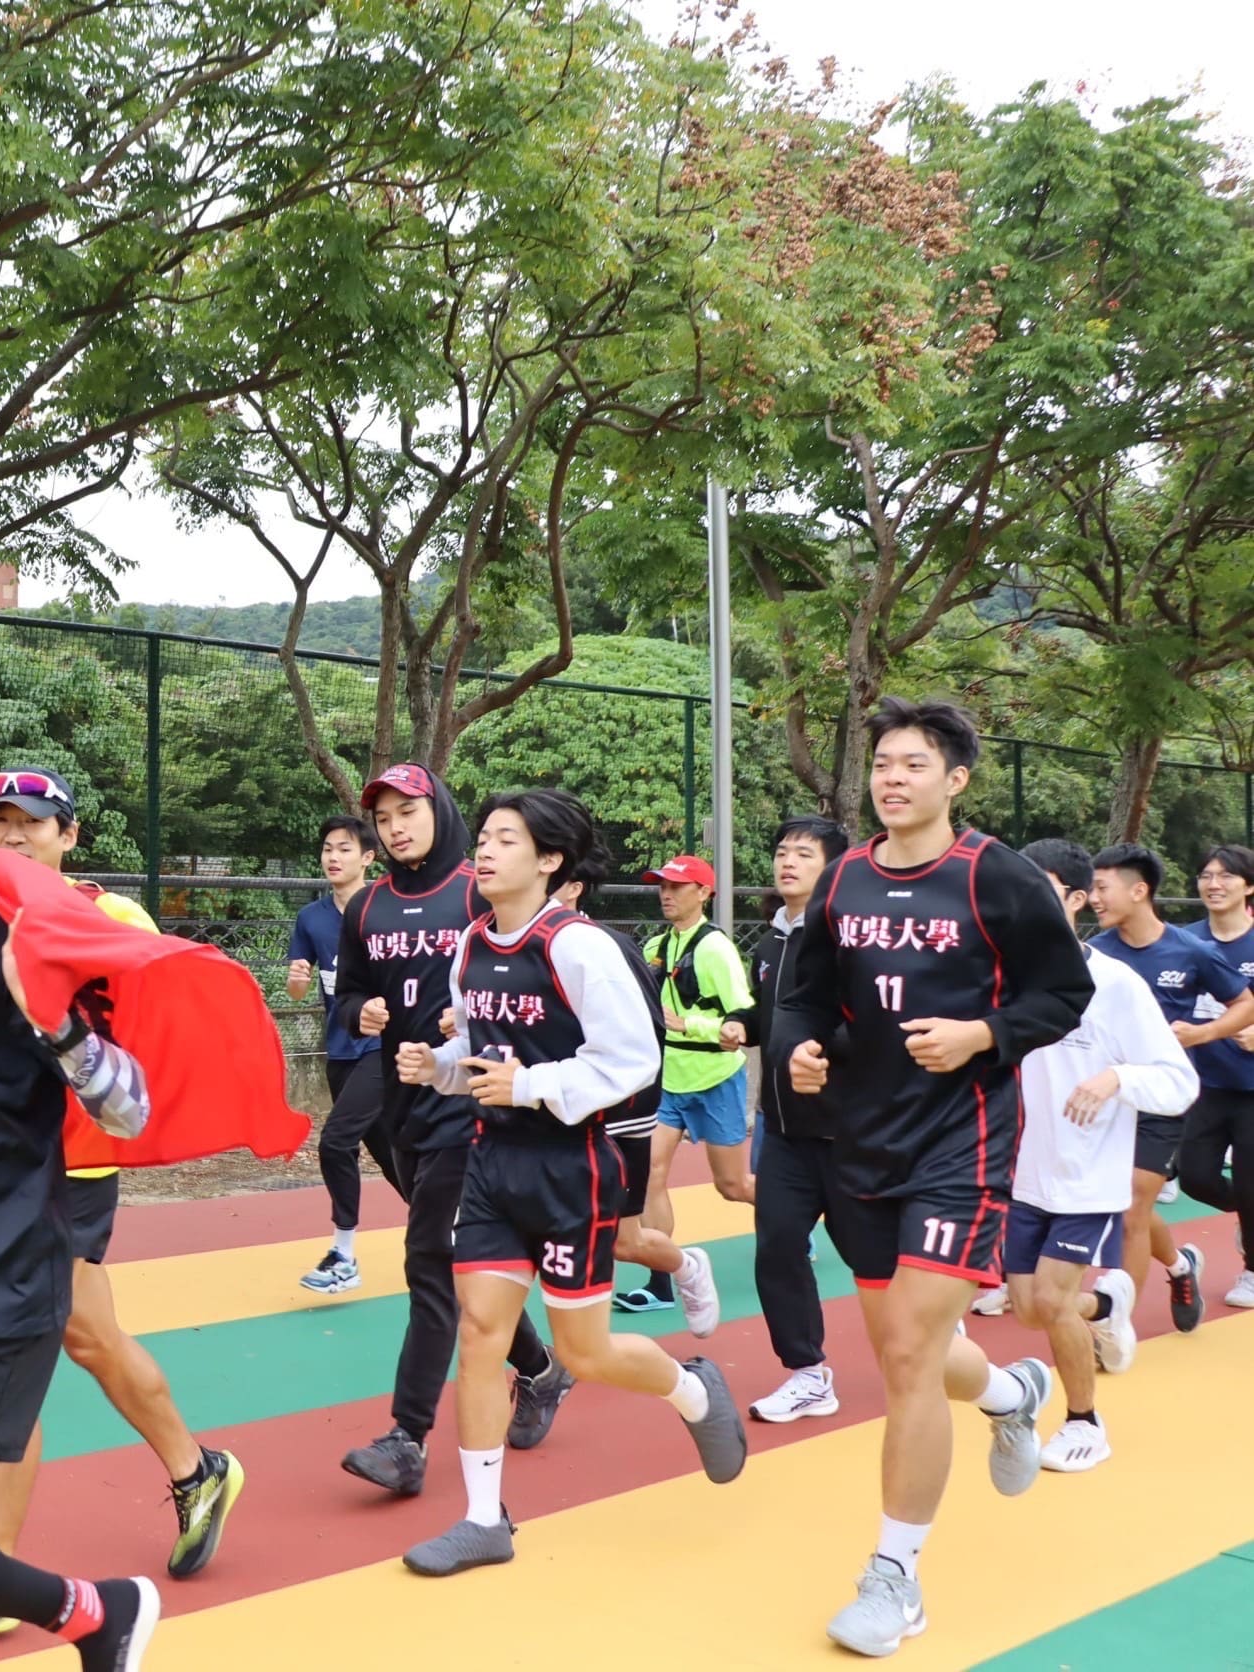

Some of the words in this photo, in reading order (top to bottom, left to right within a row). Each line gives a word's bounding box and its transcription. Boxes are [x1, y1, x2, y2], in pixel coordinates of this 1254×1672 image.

[366, 929, 460, 960] 東吳大學
[837, 914, 960, 953] 東吳大學
[404, 978, 418, 1007] 0
[874, 974, 903, 1012] 11
[1157, 970, 1186, 983] SCU
[923, 1217, 956, 1257] 11
[542, 1241, 574, 1277] 25
